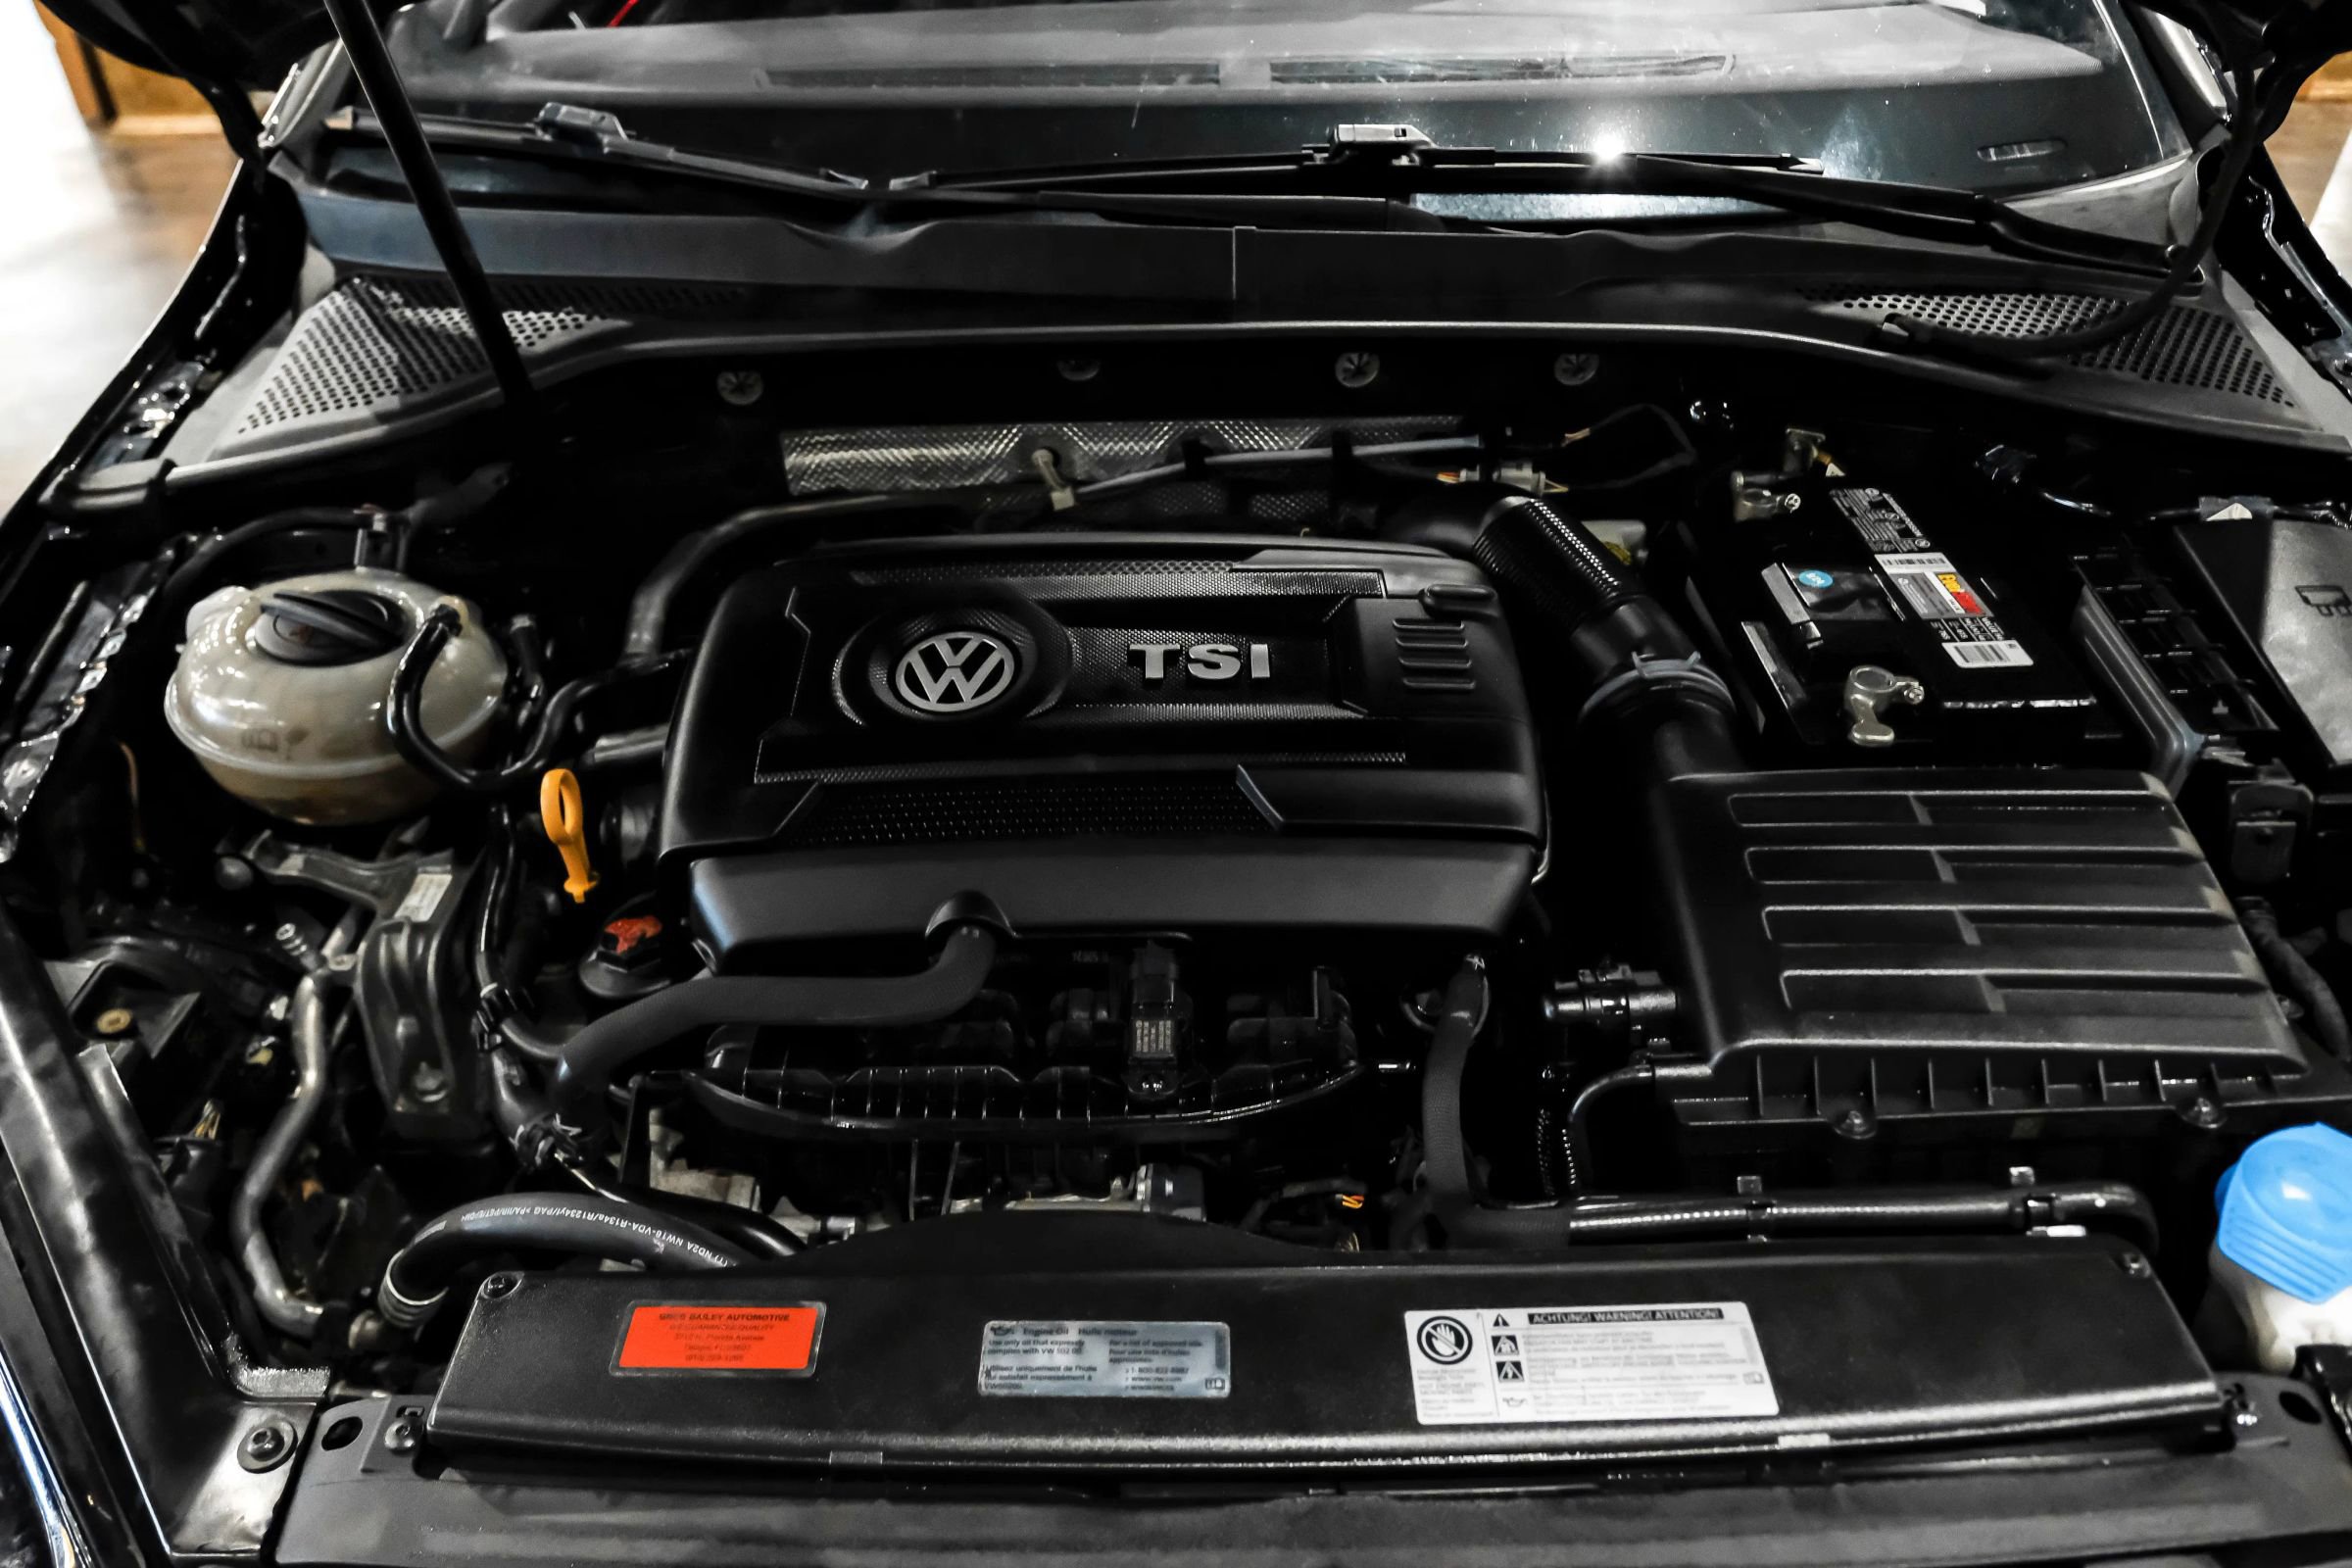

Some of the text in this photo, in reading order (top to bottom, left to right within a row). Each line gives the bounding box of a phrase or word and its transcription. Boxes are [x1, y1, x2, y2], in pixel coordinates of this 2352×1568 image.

[896, 631, 1014, 712] VW
[1129, 643, 1271, 680] TSI
[1023, 1328, 1054, 1337] Engine
